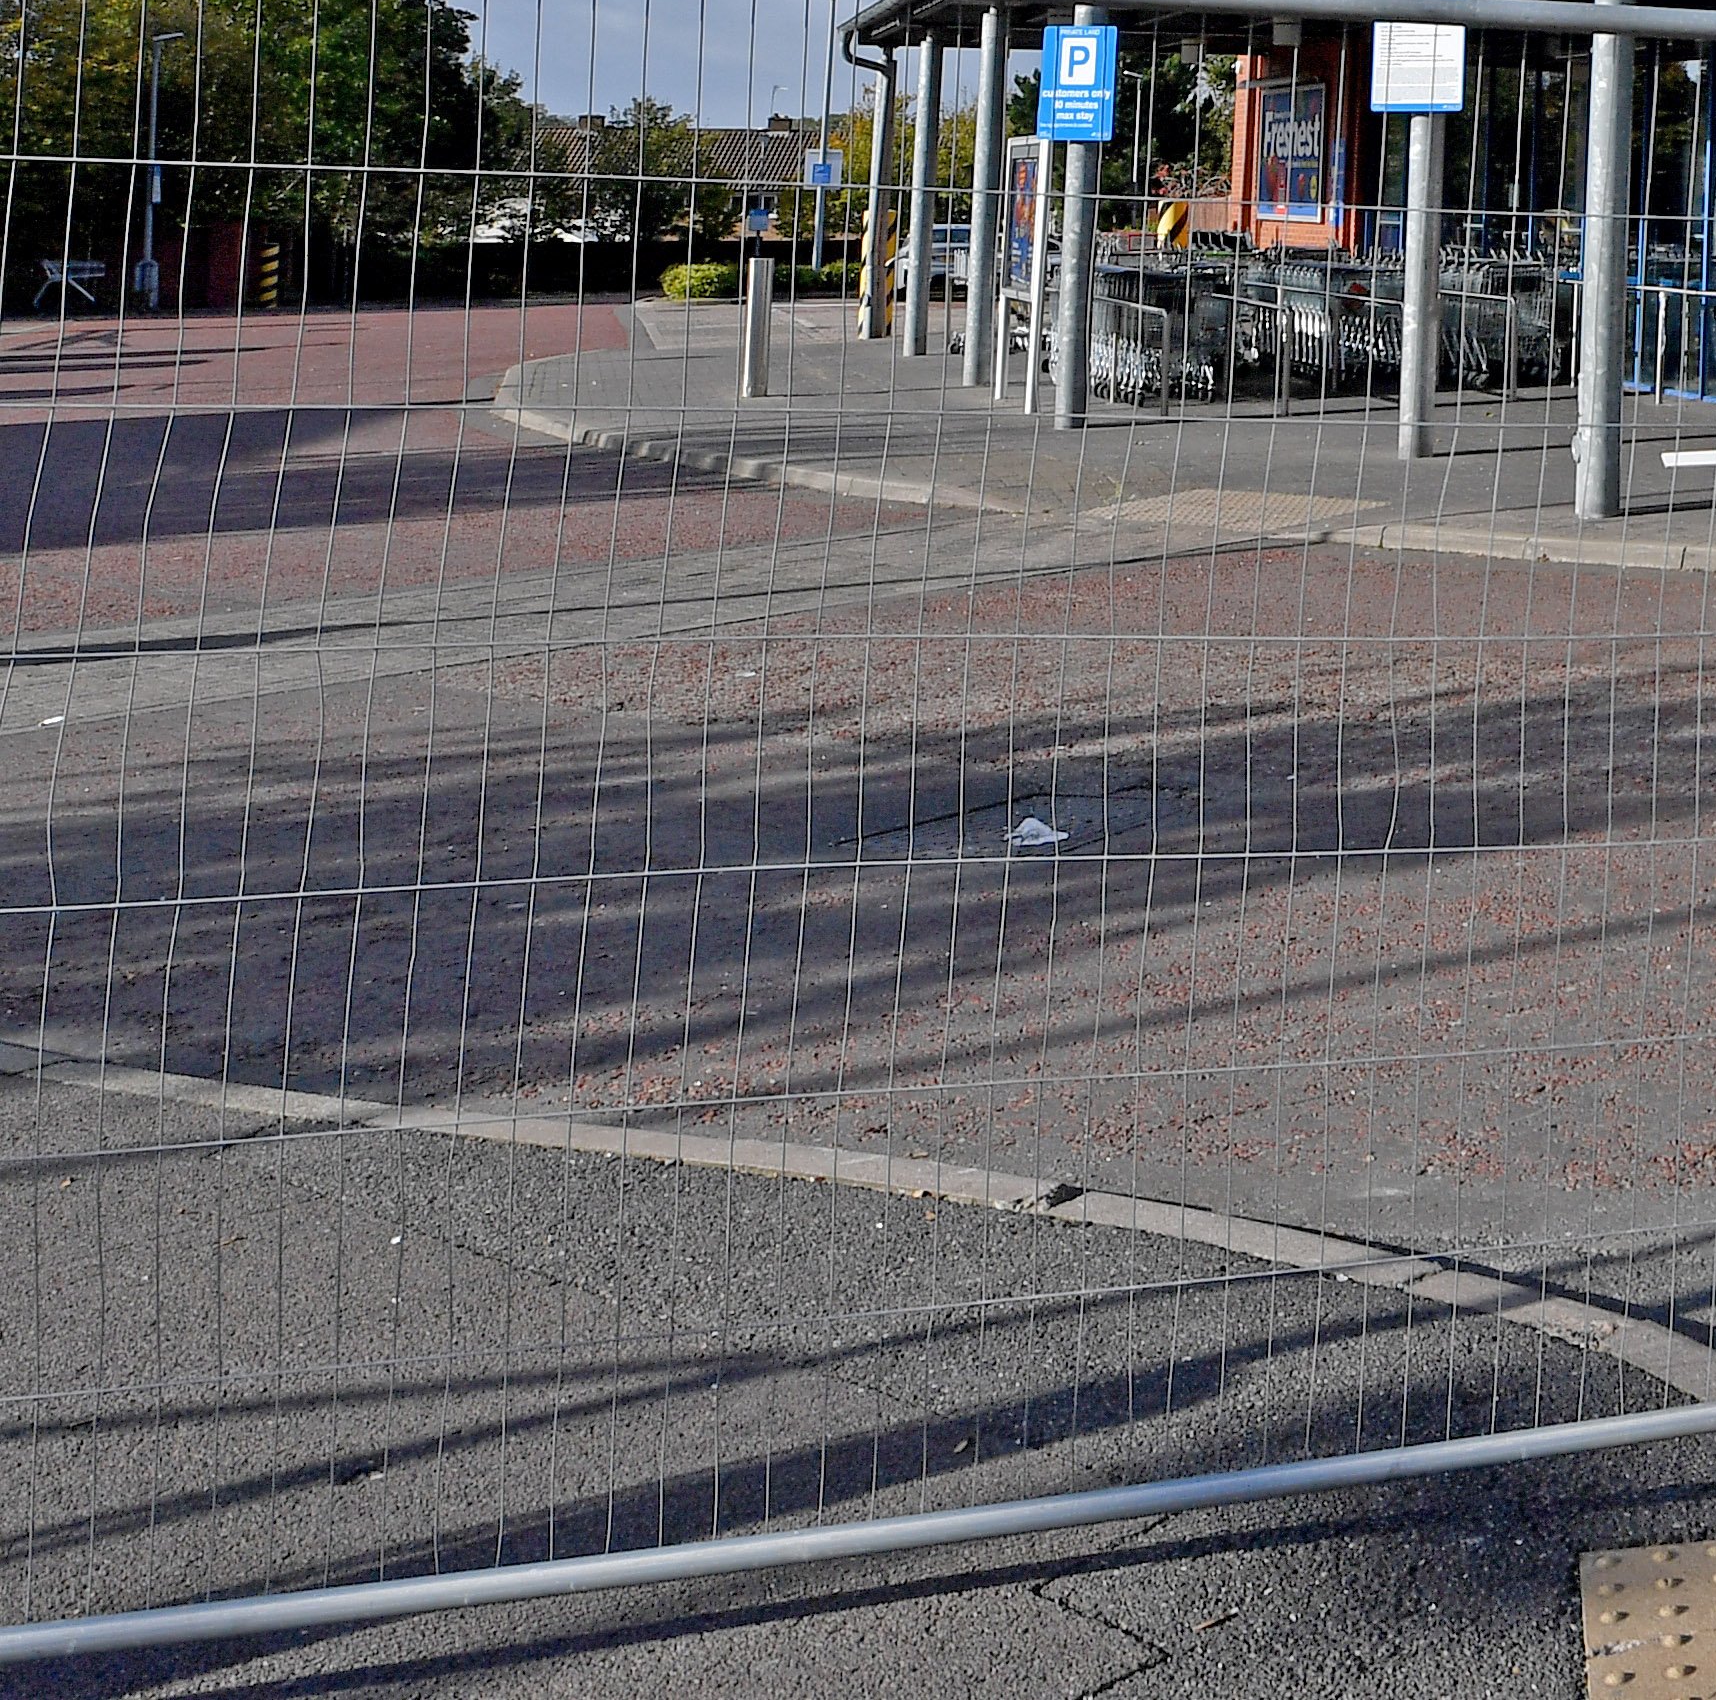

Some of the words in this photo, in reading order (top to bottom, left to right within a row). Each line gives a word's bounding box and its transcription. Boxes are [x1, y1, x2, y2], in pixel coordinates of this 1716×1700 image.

[1068, 45, 1090, 78] P
[1065, 100, 1098, 109] minutes
[1056, 112, 1073, 120] max
[1076, 111, 1094, 122] stay
